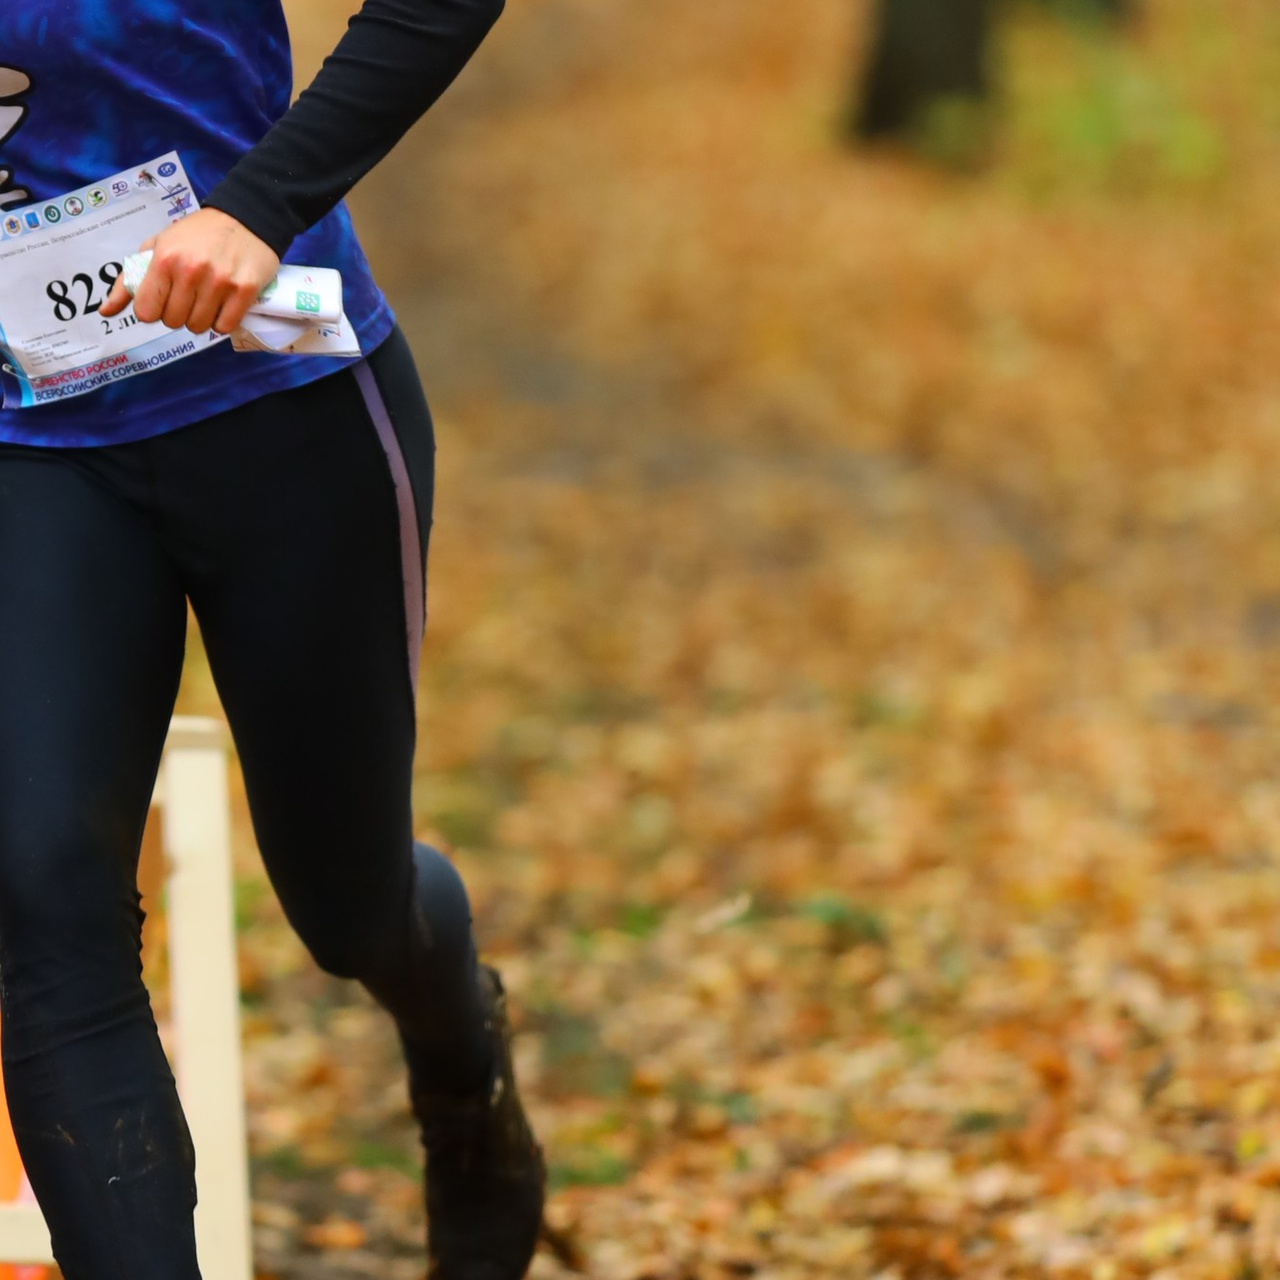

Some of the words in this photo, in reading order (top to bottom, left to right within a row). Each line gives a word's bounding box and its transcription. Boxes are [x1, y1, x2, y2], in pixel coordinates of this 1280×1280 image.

[101, 319, 113, 335] 2
[86, 354, 128, 376] РОССИИ
[112, 341, 195, 379] СОРЕВНОВАНИЯ
